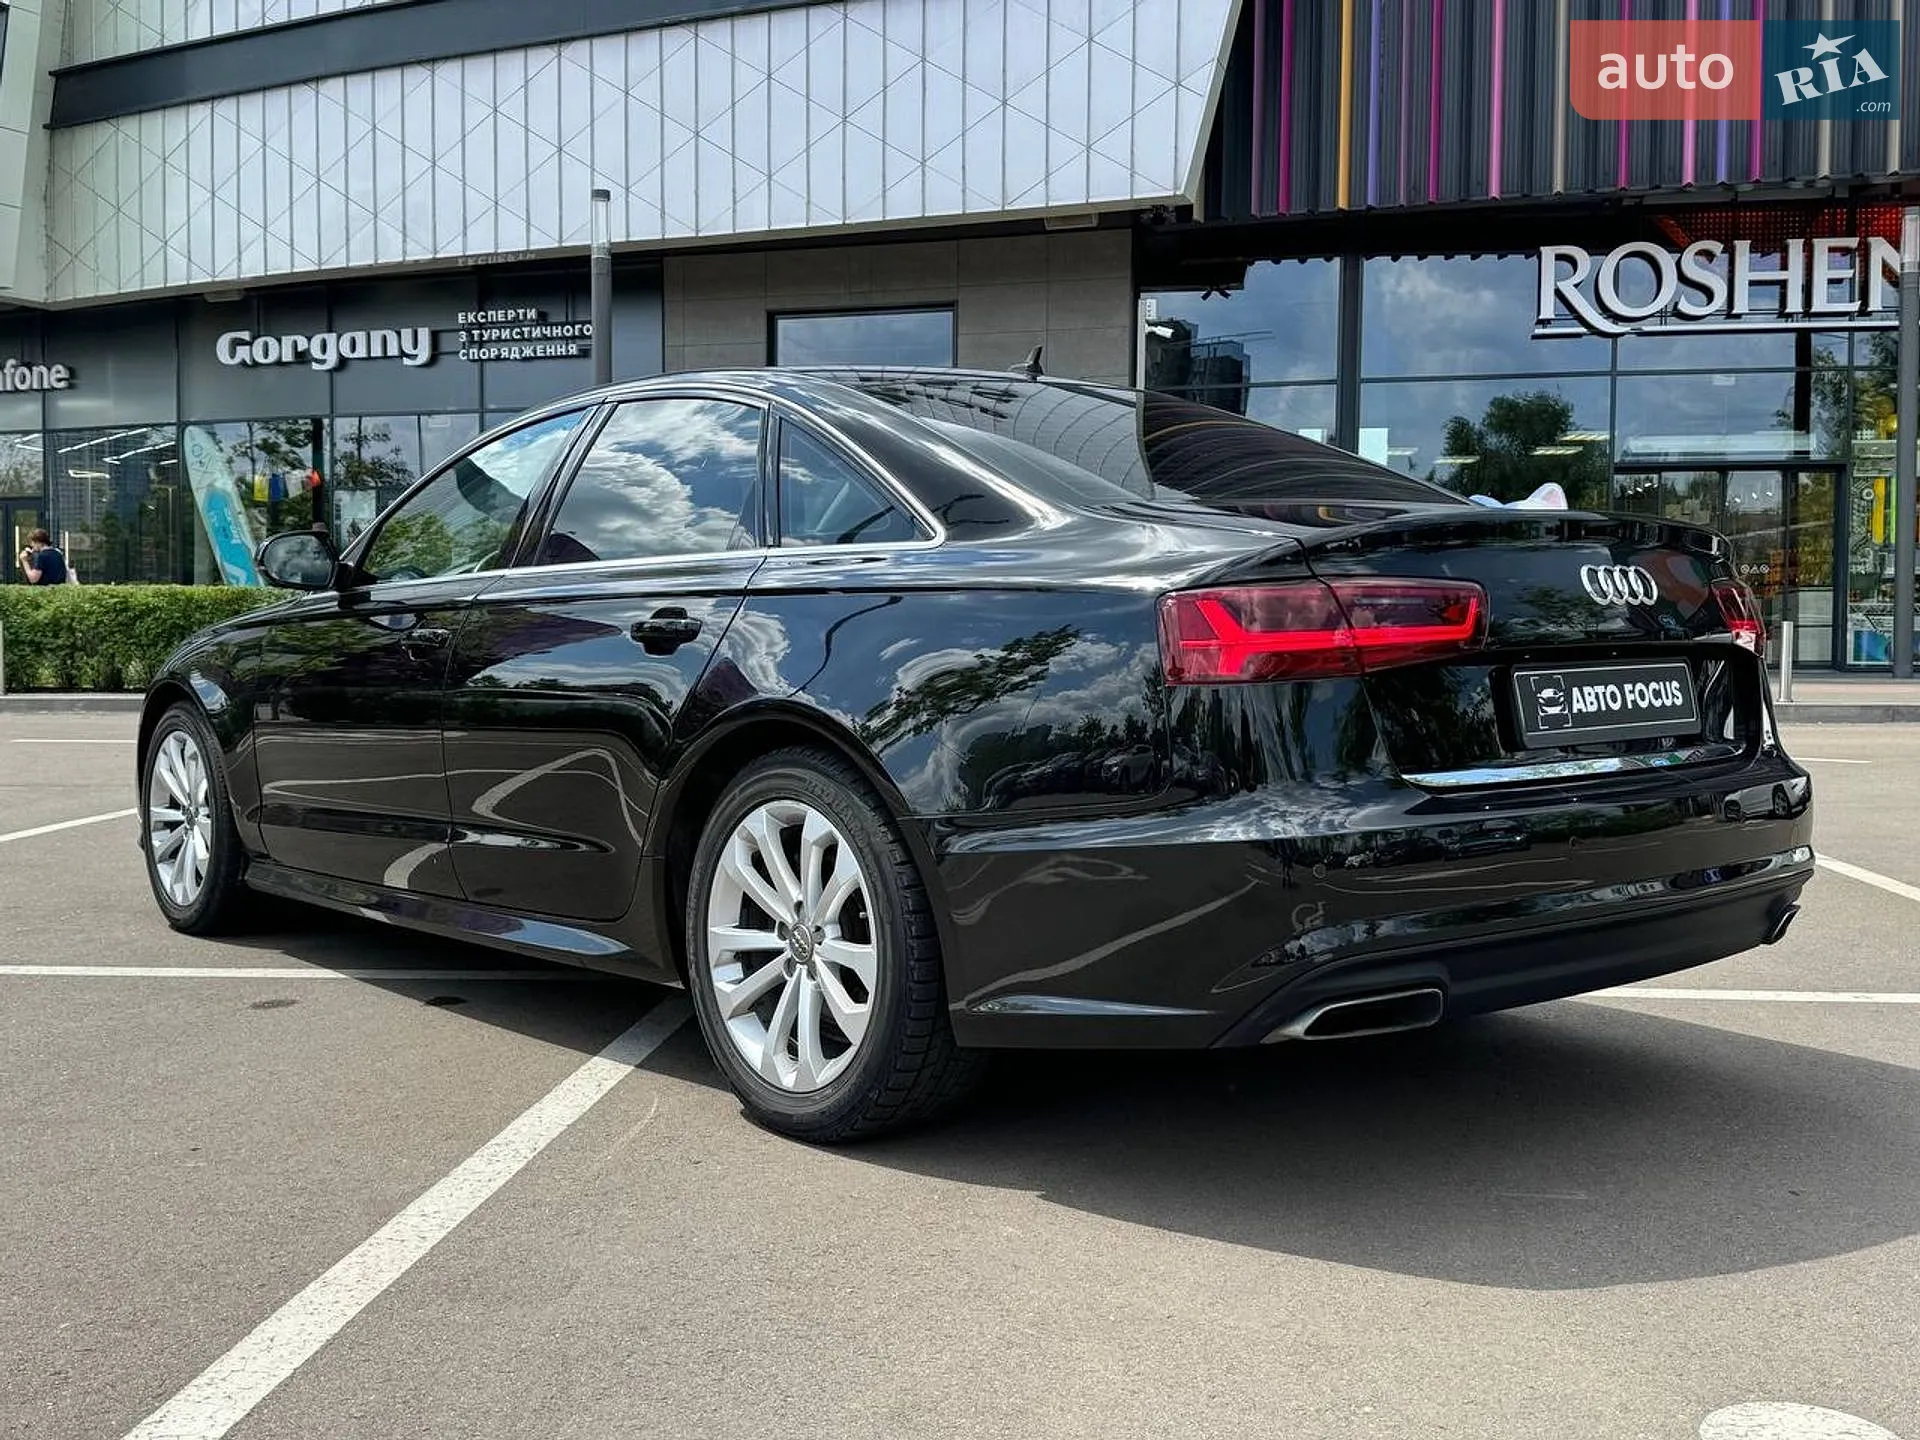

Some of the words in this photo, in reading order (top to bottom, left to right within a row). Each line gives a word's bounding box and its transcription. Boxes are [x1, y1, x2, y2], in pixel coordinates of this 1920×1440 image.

[1539, 237, 1901, 333] ROSHEN
[457, 308, 537, 324] ЕКСПЕРТИ
[472, 324, 593, 342] ТУРИСТИЧНОГО
[215, 327, 432, 371] Gorgany
[458, 343, 578, 360] СПОРЯДЖЕННЯ
[1623, 680, 1683, 709] FOCUS
